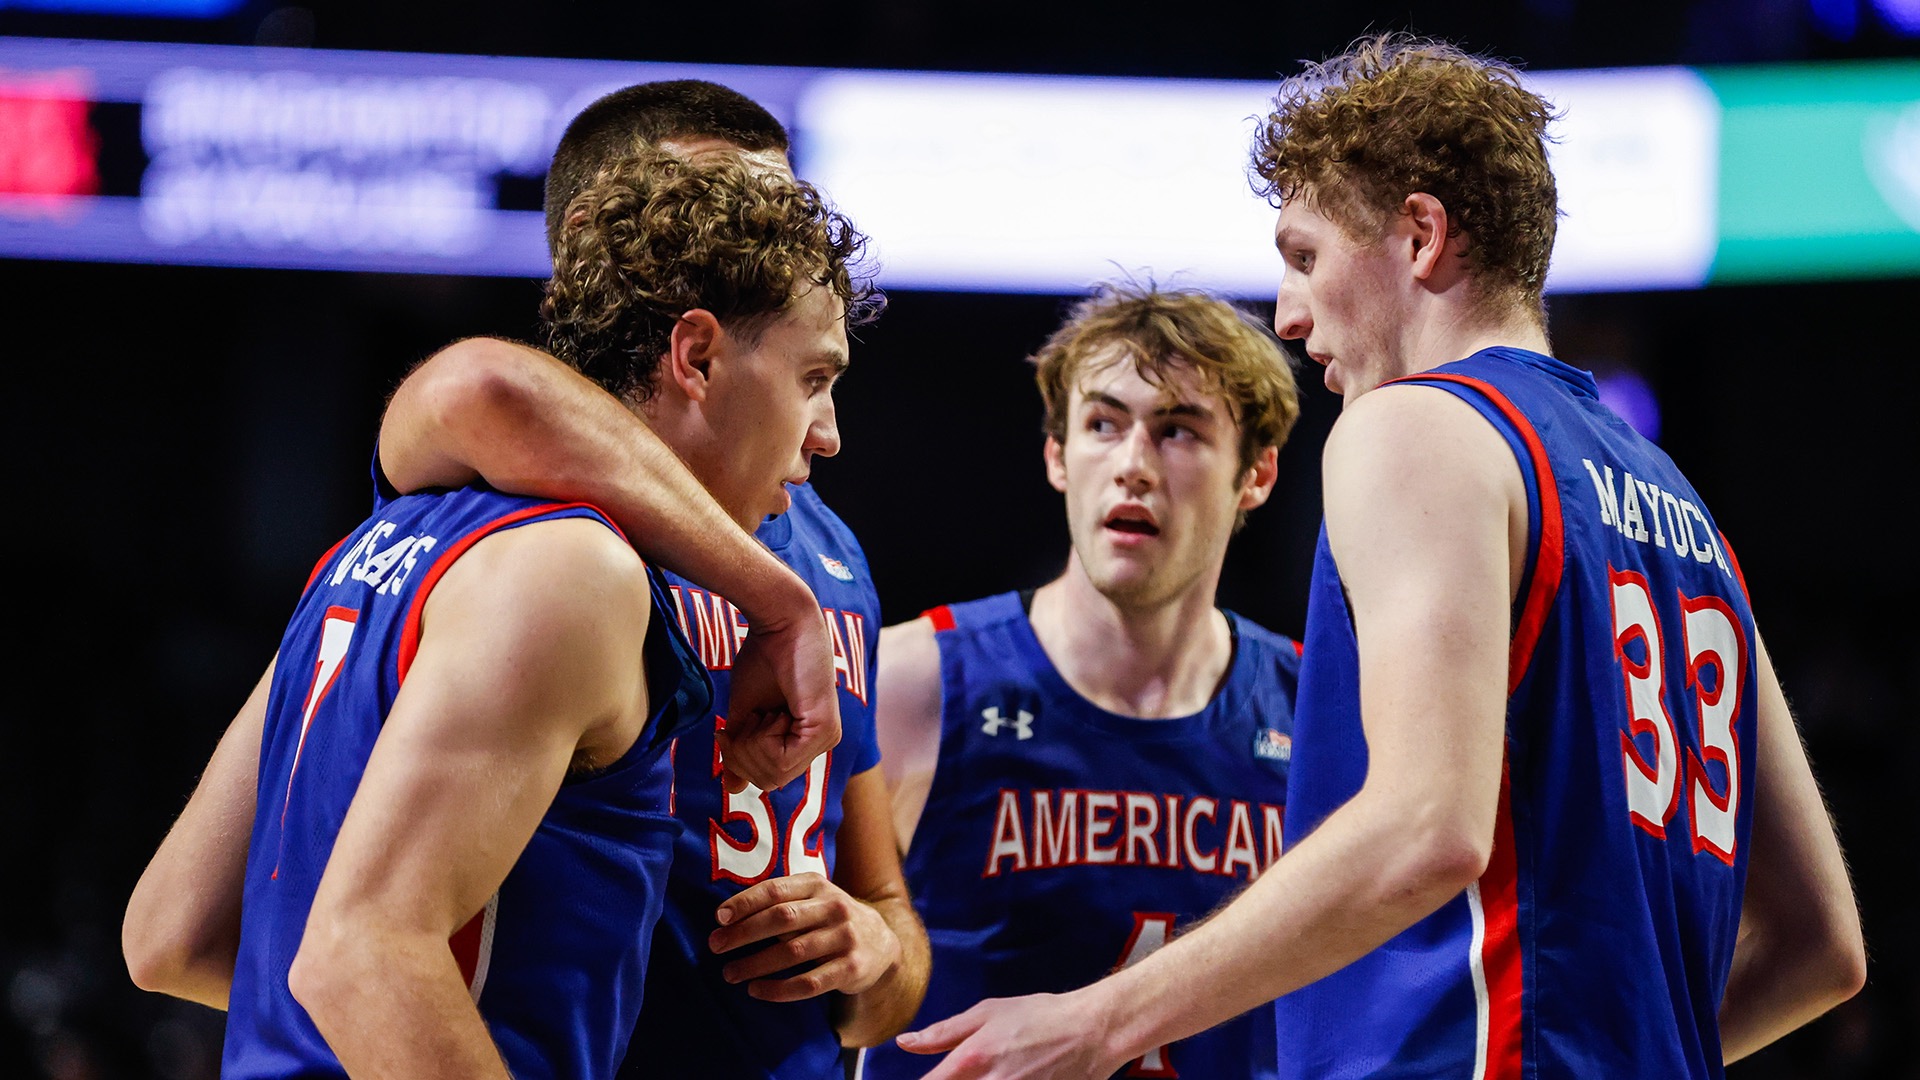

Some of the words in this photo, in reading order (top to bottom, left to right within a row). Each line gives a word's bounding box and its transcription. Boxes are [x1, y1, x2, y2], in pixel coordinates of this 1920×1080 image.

[271, 605, 360, 880] 7
[977, 787, 1287, 882] AMERICAN
[1607, 560, 1748, 867] 33
